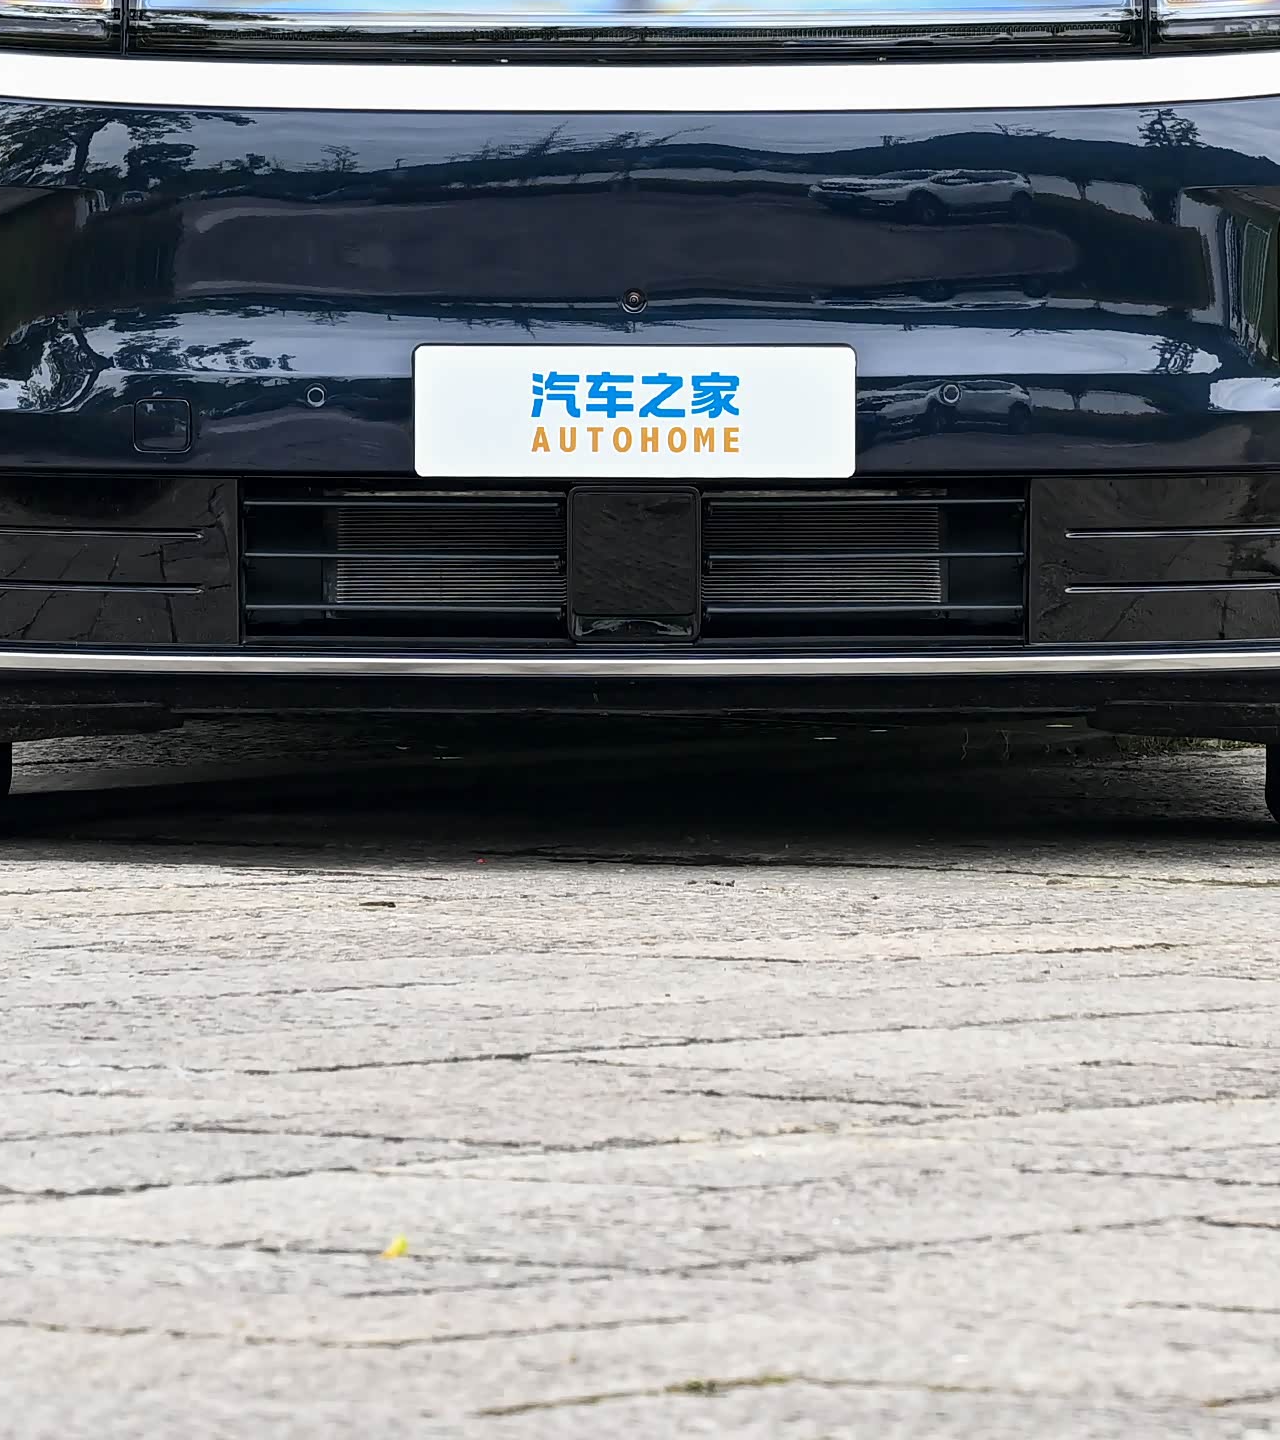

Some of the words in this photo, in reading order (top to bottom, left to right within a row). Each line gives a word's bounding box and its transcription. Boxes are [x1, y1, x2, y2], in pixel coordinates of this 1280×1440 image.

[531, 371, 740, 419] 汽车之家
[531, 427, 740, 453] AUTOHOME
